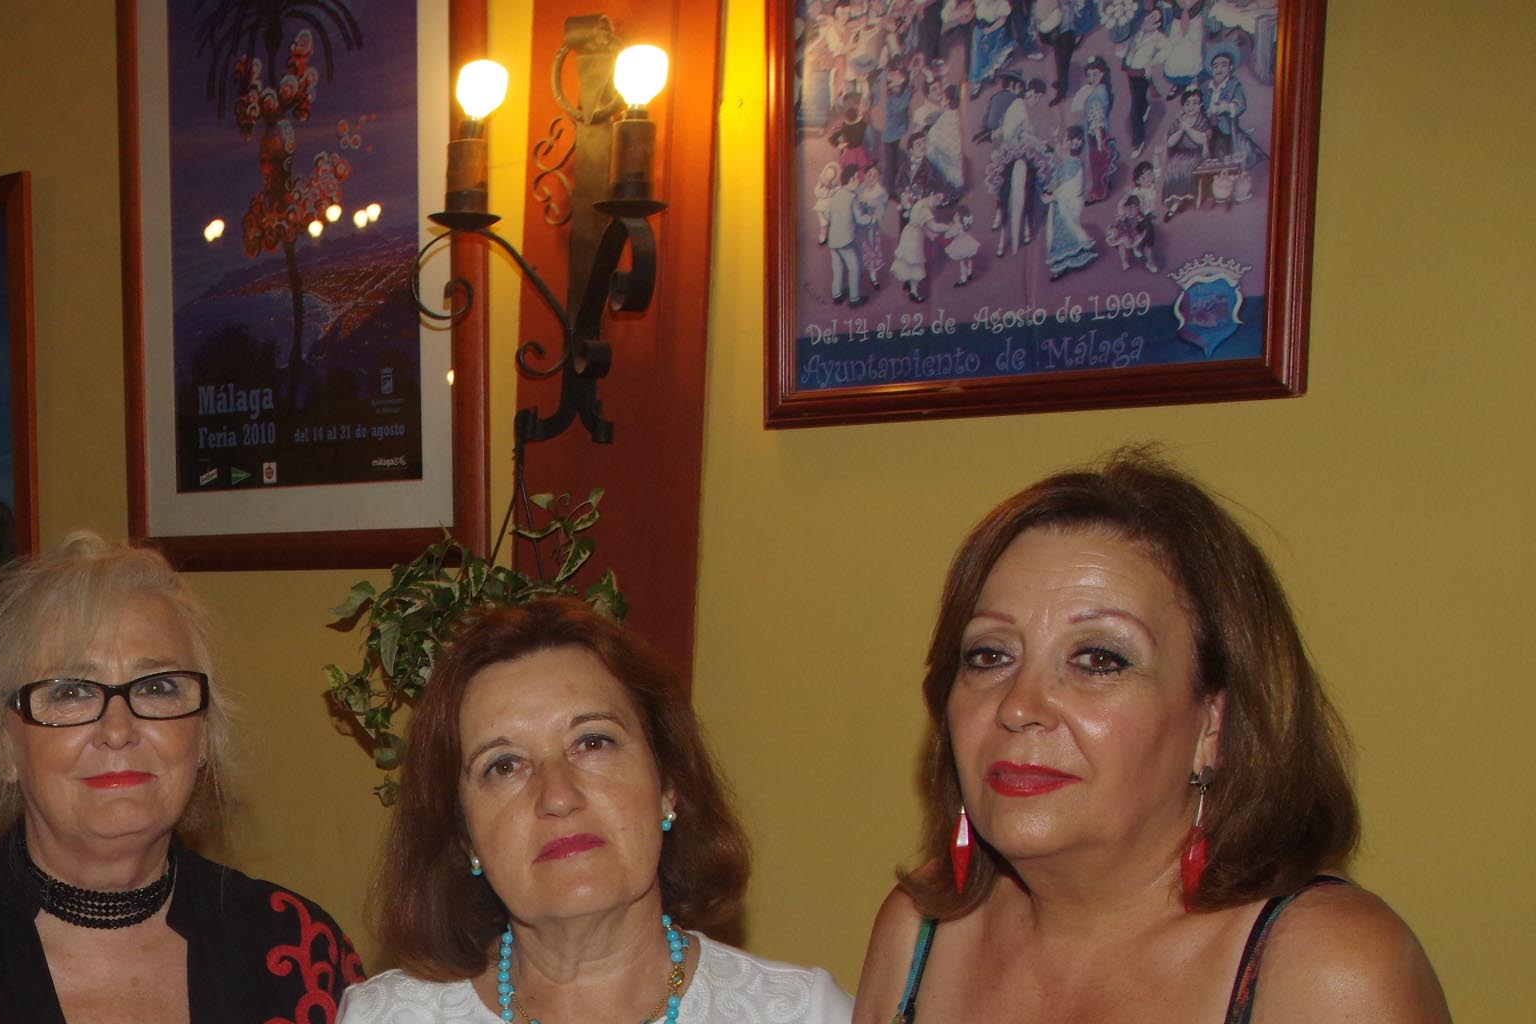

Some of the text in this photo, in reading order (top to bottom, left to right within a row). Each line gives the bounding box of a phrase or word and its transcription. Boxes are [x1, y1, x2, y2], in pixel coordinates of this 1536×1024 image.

[805, 290, 1152, 346] Del 14 al 22 de Agosto de 1999
[800, 329, 1146, 389] Ayuntamiento de Málaga
[197, 382, 275, 421] Málaga
[197, 421, 276, 449] Feria 2010
[293, 428, 309, 443] del
[327, 426, 336, 441] al
[355, 424, 368, 439] de
[370, 423, 406, 441] agosto
